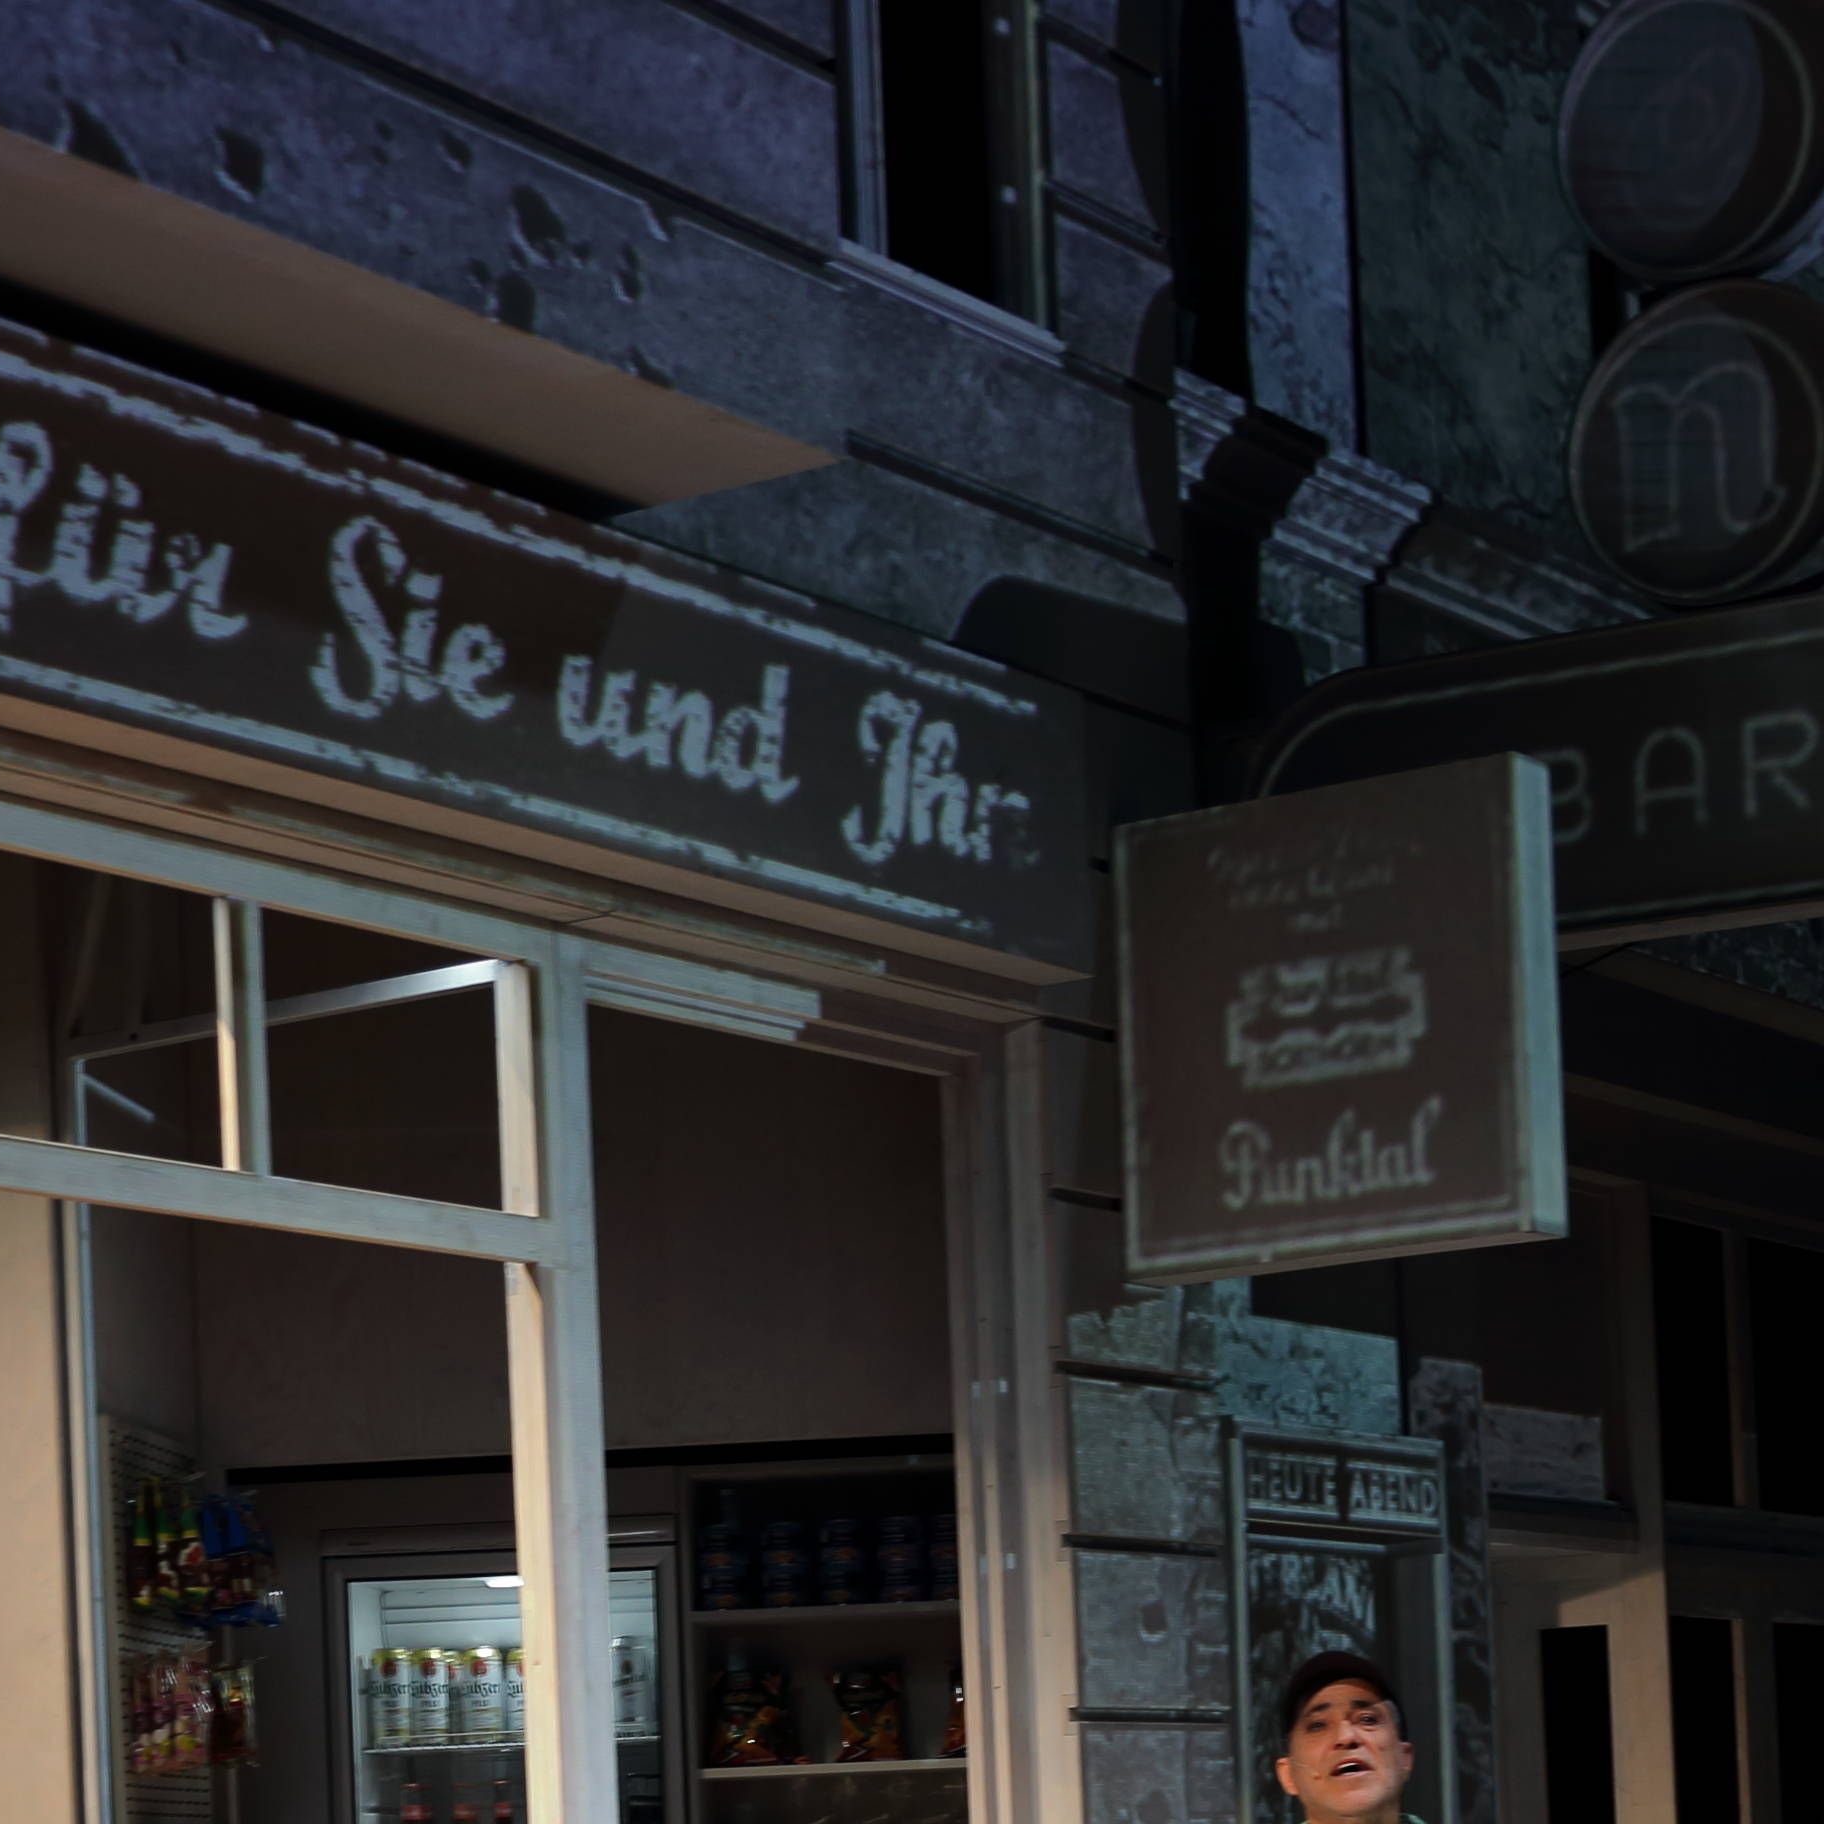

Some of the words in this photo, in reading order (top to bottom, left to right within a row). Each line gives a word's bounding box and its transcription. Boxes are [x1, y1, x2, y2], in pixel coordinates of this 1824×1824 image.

[308, 514, 515, 721] Sie
[555, 653, 800, 801] und
[1246, 1457, 1338, 1507] HEUTE
[1349, 1467, 1440, 1517] ABEND
